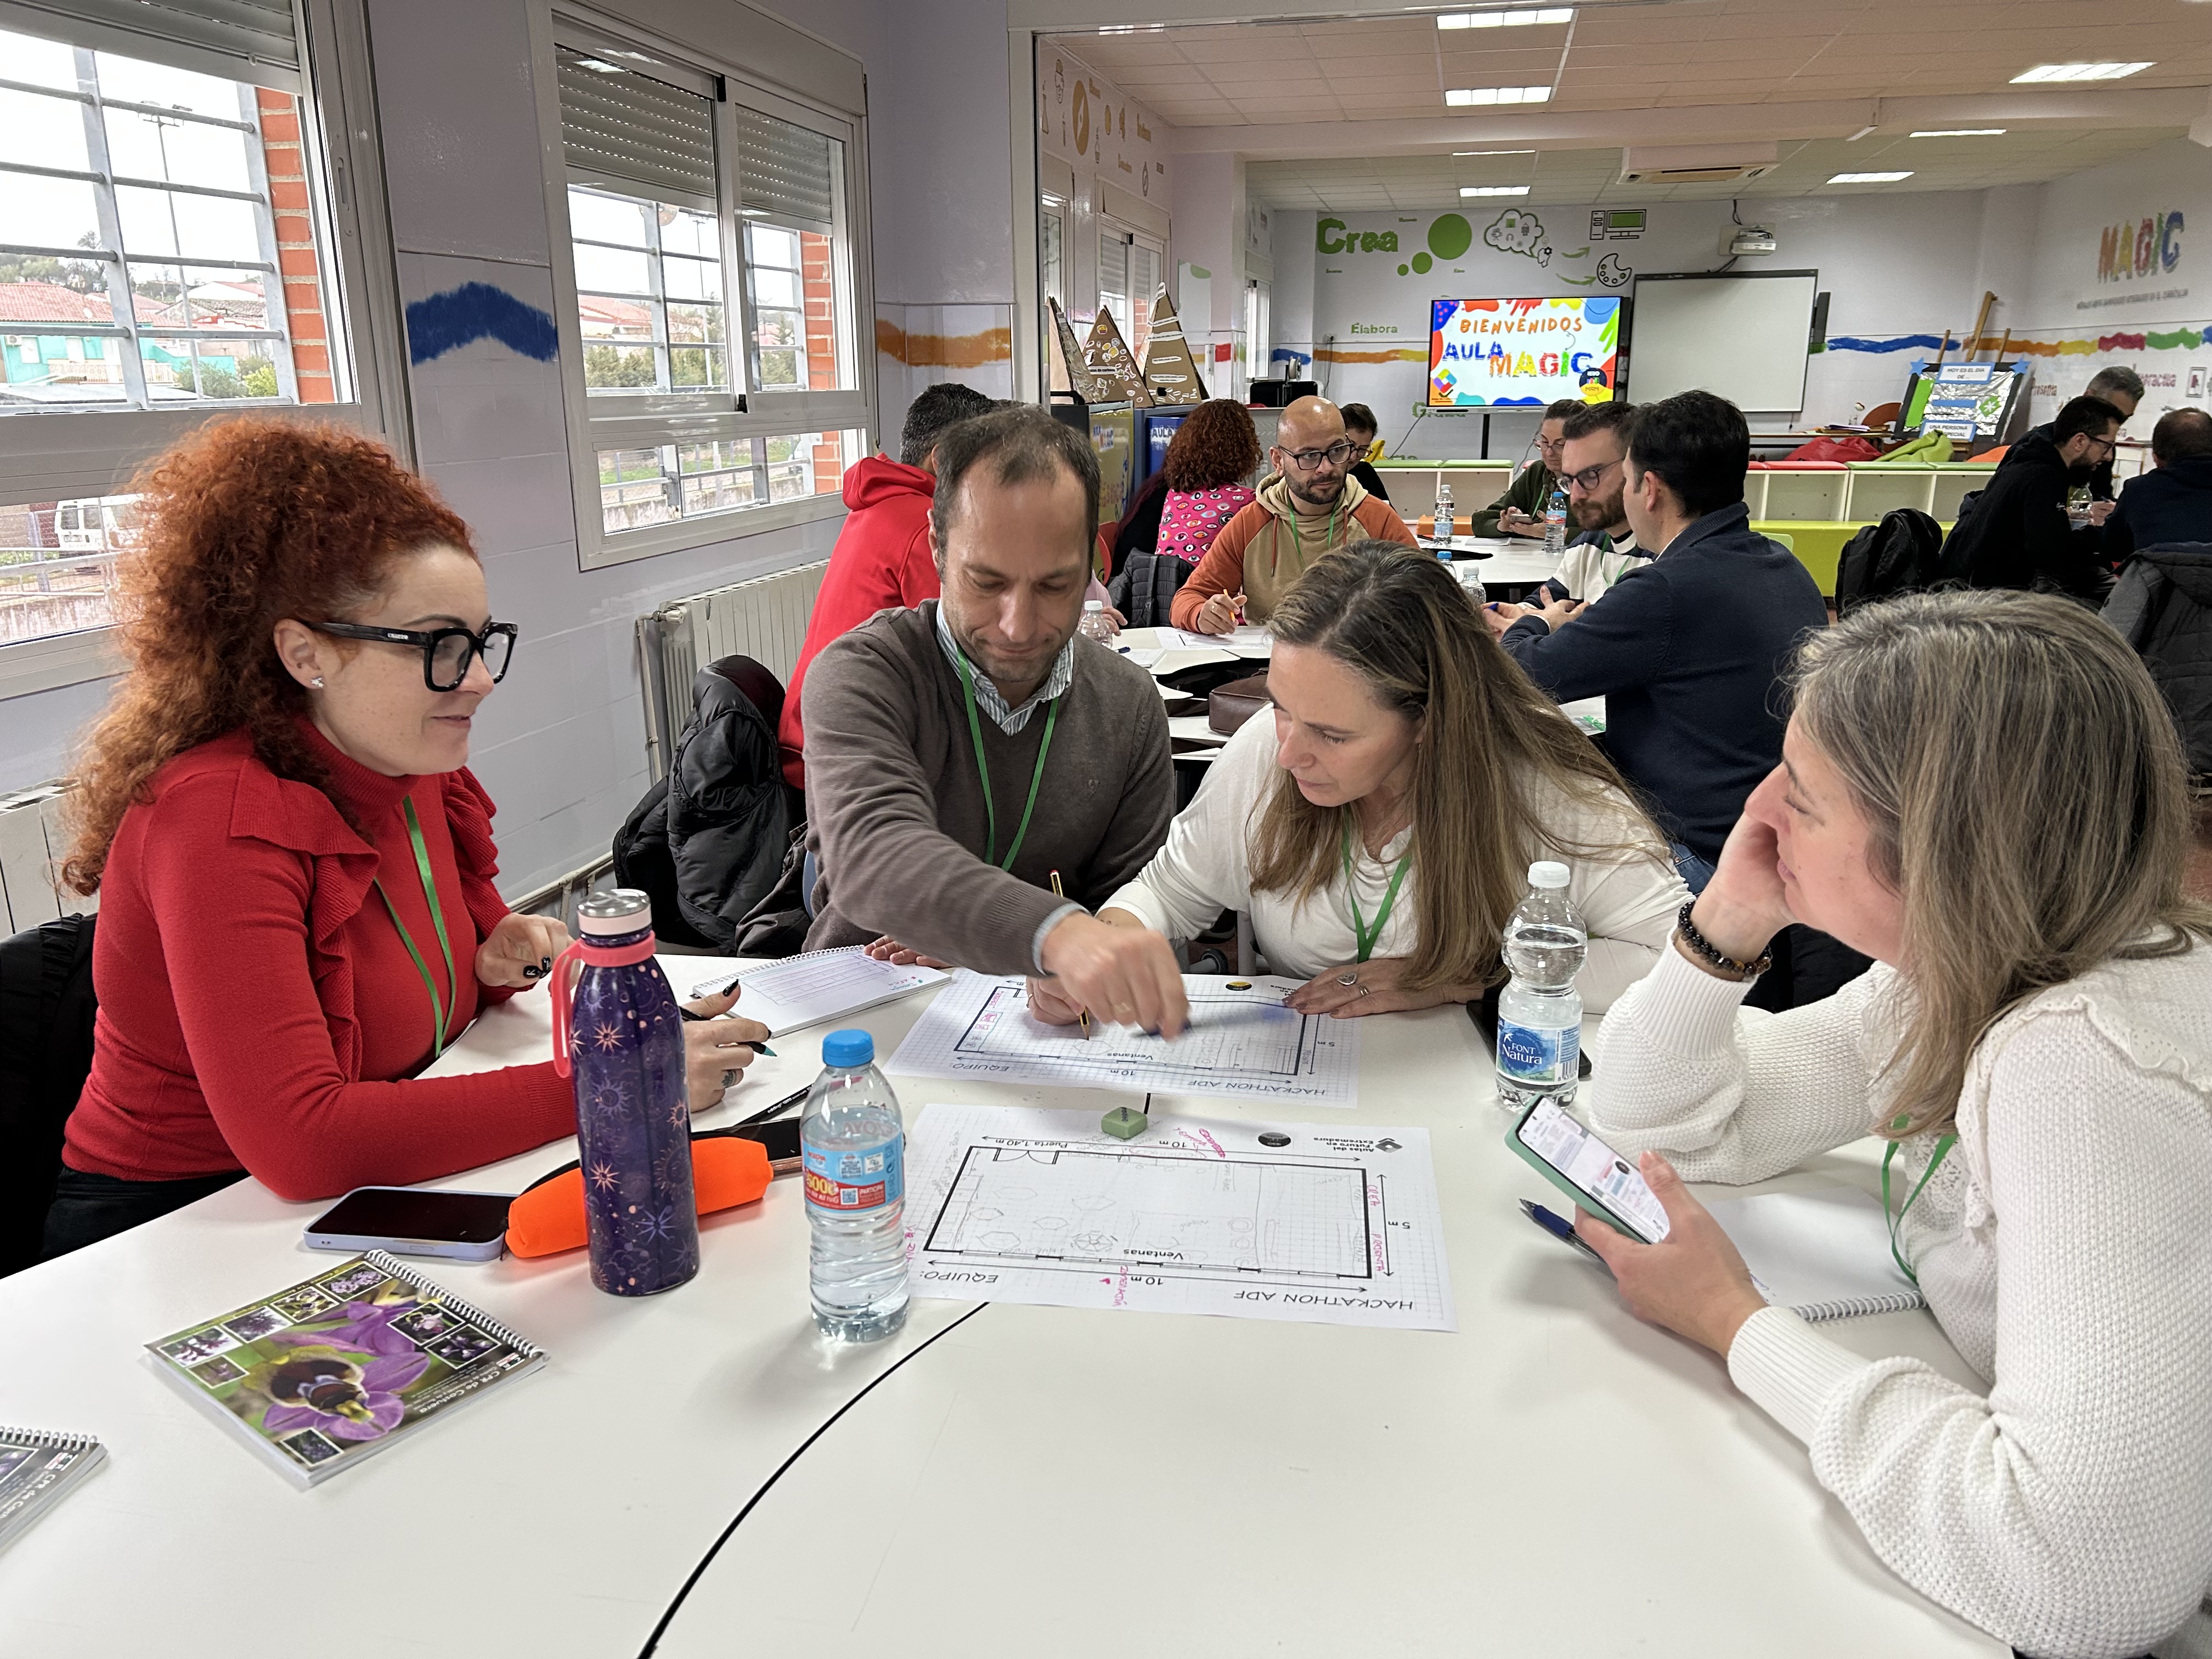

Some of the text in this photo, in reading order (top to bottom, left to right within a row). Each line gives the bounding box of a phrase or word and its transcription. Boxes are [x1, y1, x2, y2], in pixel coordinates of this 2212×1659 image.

[1317, 217, 1398, 255] Crea
[2098, 210, 2186, 284] MAGIC
[1460, 317, 1583, 335] BIENVENIDOS
[1442, 341, 1505, 361] AULA
[1488, 351, 1594, 378] MAGIC
[1502, 1043, 1543, 1065] Natura
[1511, 1043, 1536, 1055] FONT
[1107, 1052, 1154, 1061] Ventanas
[949, 1063, 1009, 1072] EQUIPO:
[1226, 1082, 1325, 1096] HACKATHON
[1167, 1141, 1187, 1149] 10
[1402, 1221, 1410, 1230] 5
[1122, 1248, 1184, 1261] Ventanas
[919, 1270, 999, 1284] EQUIPO:
[1145, 1276, 1164, 1286] 10
[1232, 1290, 1413, 1311] HACKATHON ADF
